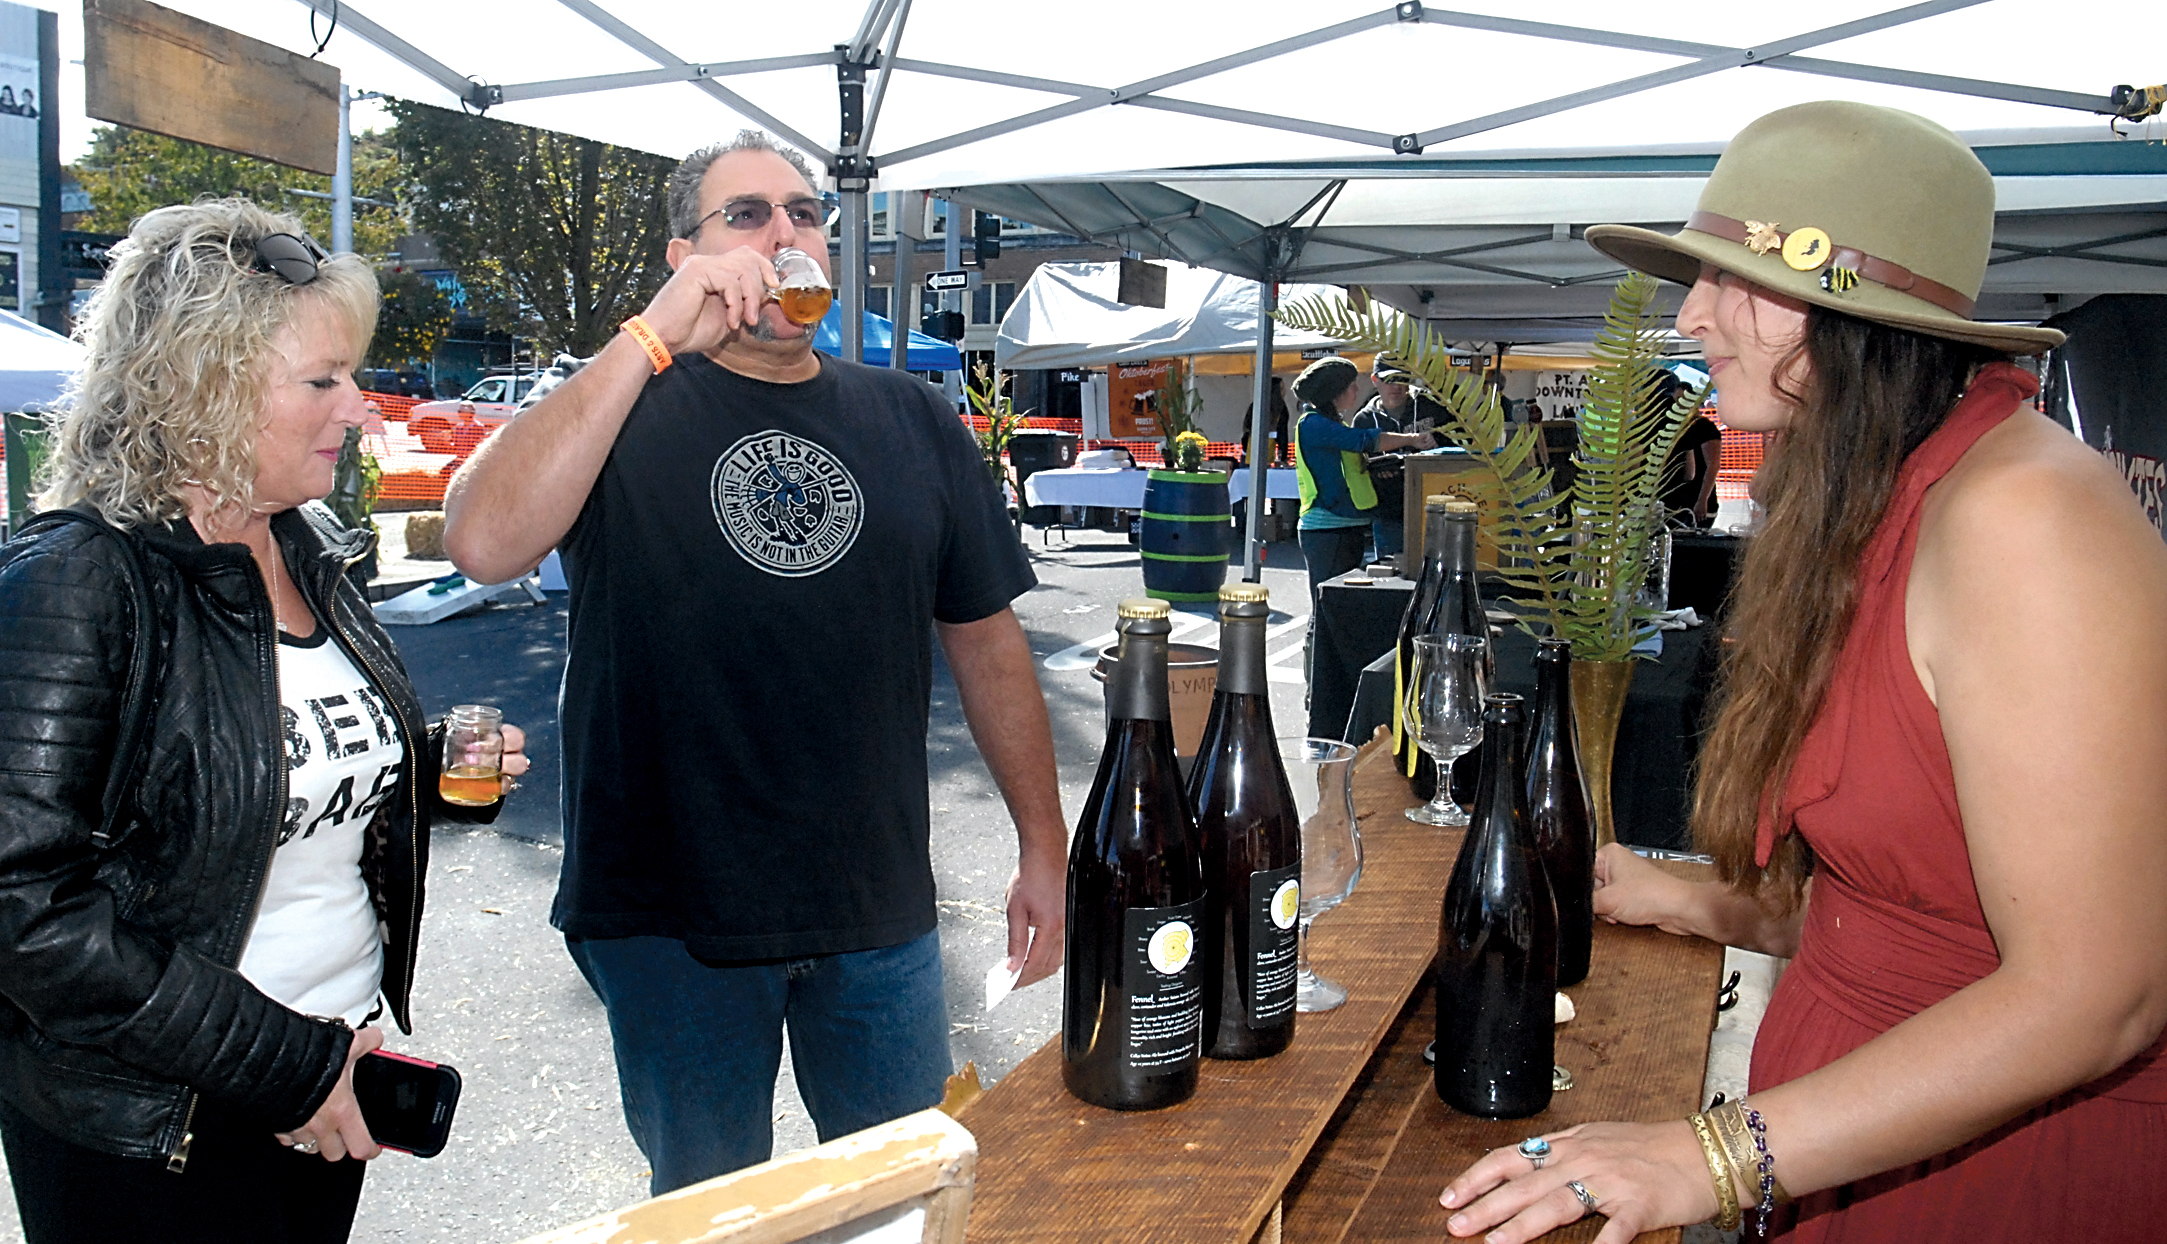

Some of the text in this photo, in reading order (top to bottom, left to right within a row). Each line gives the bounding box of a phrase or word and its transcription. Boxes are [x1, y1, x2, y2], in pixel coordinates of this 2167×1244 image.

[937, 276, 963, 285] ONE WAY
[651, 346, 666, 364] ARTS
[1060, 371, 1080, 382] Pike
[1119, 363, 1171, 379] Oktoberfest
[1555, 374, 1573, 385] PT.
[731, 438, 853, 503] LIFE IS GOOD
[725, 480, 849, 563] THE MUSIC IS NOT IN THE GUITAR
[1168, 676, 1215, 694] LYMP
